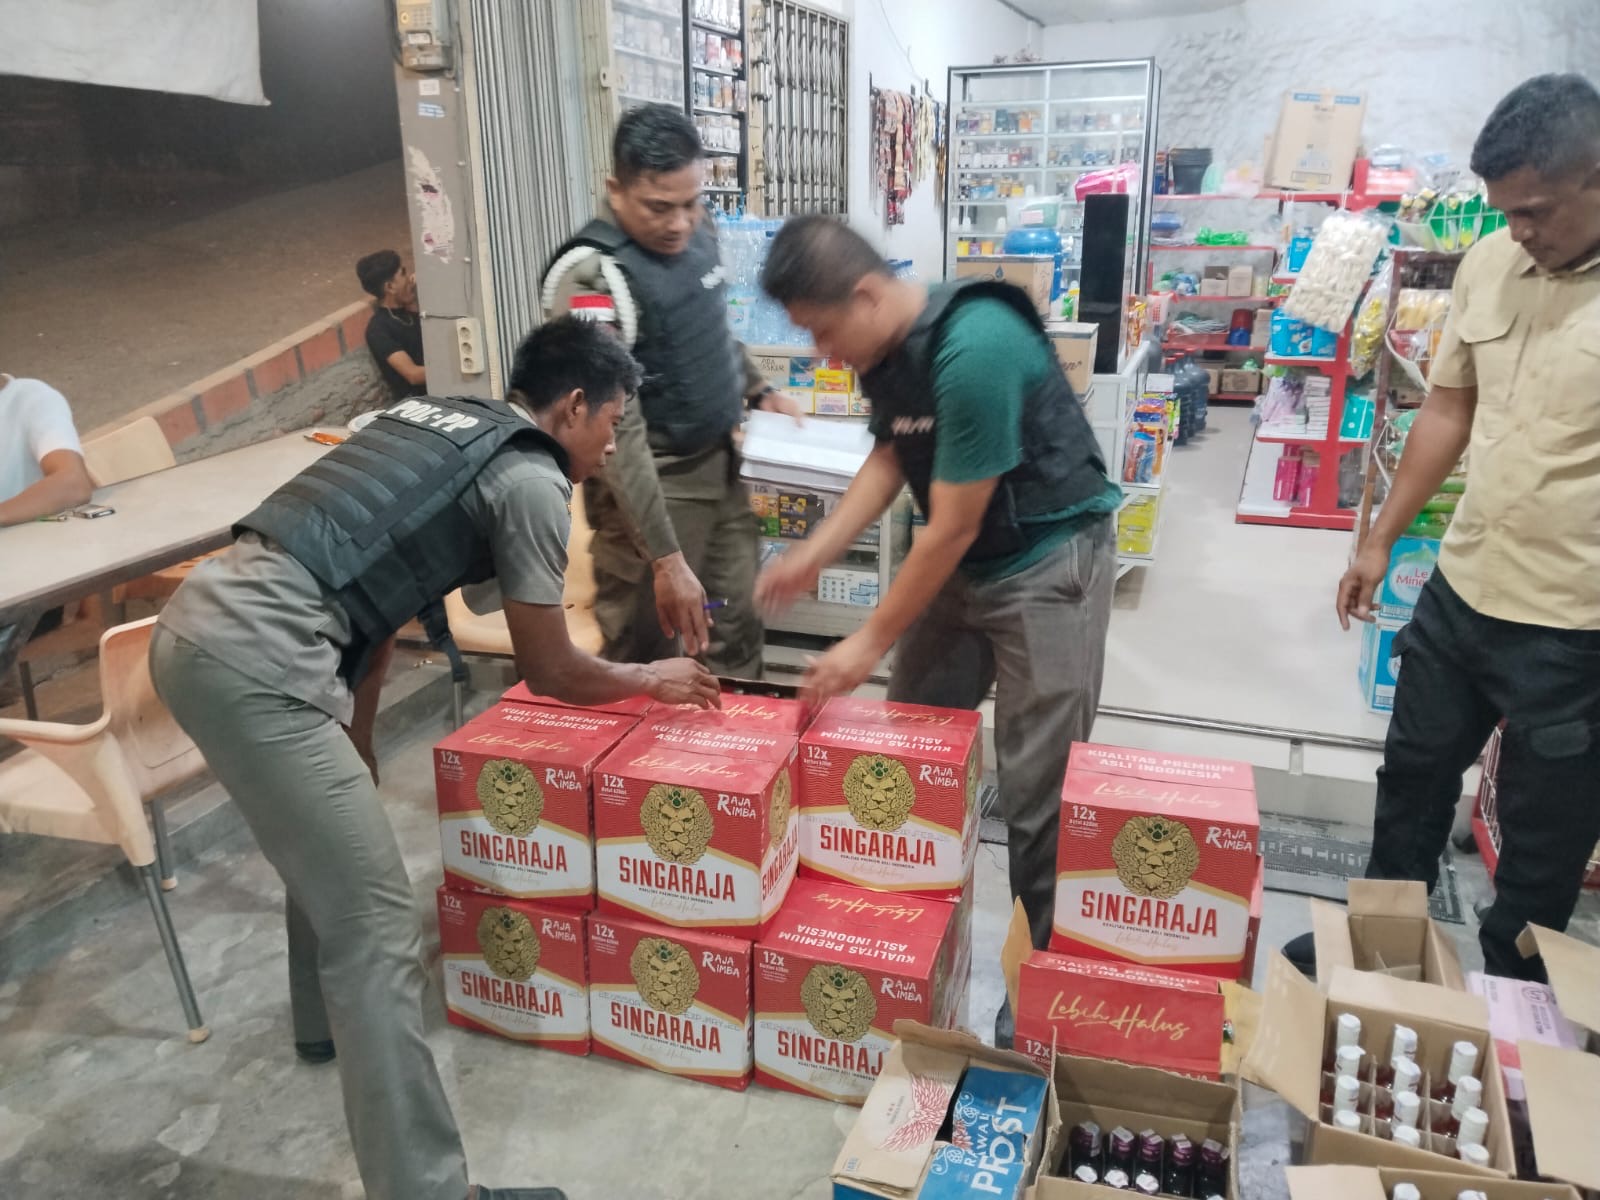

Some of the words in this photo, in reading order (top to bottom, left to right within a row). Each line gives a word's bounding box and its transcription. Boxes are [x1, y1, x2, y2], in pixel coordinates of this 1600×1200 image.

[386, 399, 480, 432] POL-PP
[1396, 575, 1425, 586] Mine
[1415, 568, 1429, 578] Le
[501, 707, 558, 720] KUALITAS
[559, 715, 618, 727] PREMIUM
[503, 715, 530, 723] ASLI
[532, 718, 599, 731] INDONESIA
[651, 724, 710, 739] KUALITAS
[714, 734, 777, 747] PREMIUM
[655, 733, 684, 743] ASLI
[688, 738, 759, 753] INDONESIA
[819, 731, 883, 746] PREMIUM
[837, 727, 908, 742] INDONESIA
[912, 736, 943, 746] ASLI
[807, 746, 828, 760] 12x
[888, 740, 951, 752] KUALITAS
[440, 751, 460, 765] 12x
[1087, 749, 1158, 765] KUALITAS
[1162, 759, 1235, 773] PREMIUM
[1099, 759, 1132, 769] ASLI
[1138, 763, 1222, 780] INDONESIA
[602, 774, 624, 788] 12x
[1072, 805, 1096, 820] 12x
[460, 830, 567, 872] SINGARAJA
[820, 825, 936, 867] SINGARAJA
[619, 856, 735, 902] SINGARAJA
[443, 895, 462, 909] 12x
[1081, 890, 1218, 937] SINGARAJA
[594, 923, 615, 938] 12x
[797, 925, 872, 945] INDONESIA
[777, 931, 844, 951] PREMIUM
[876, 939, 908, 952] ASLI
[763, 951, 784, 966] 12x
[848, 946, 916, 963] KUALITAS
[1047, 957, 1117, 972] KUALITAS
[1124, 969, 1200, 985] PREMIUM
[1056, 965, 1092, 975] ASLI
[1098, 971, 1185, 988] INDONESIA
[461, 970, 563, 1018] SINGARAJA
[611, 1001, 721, 1053] SINGARAJA
[778, 1030, 884, 1075] SINGARAJ
[1025, 1040, 1050, 1057] 12x
